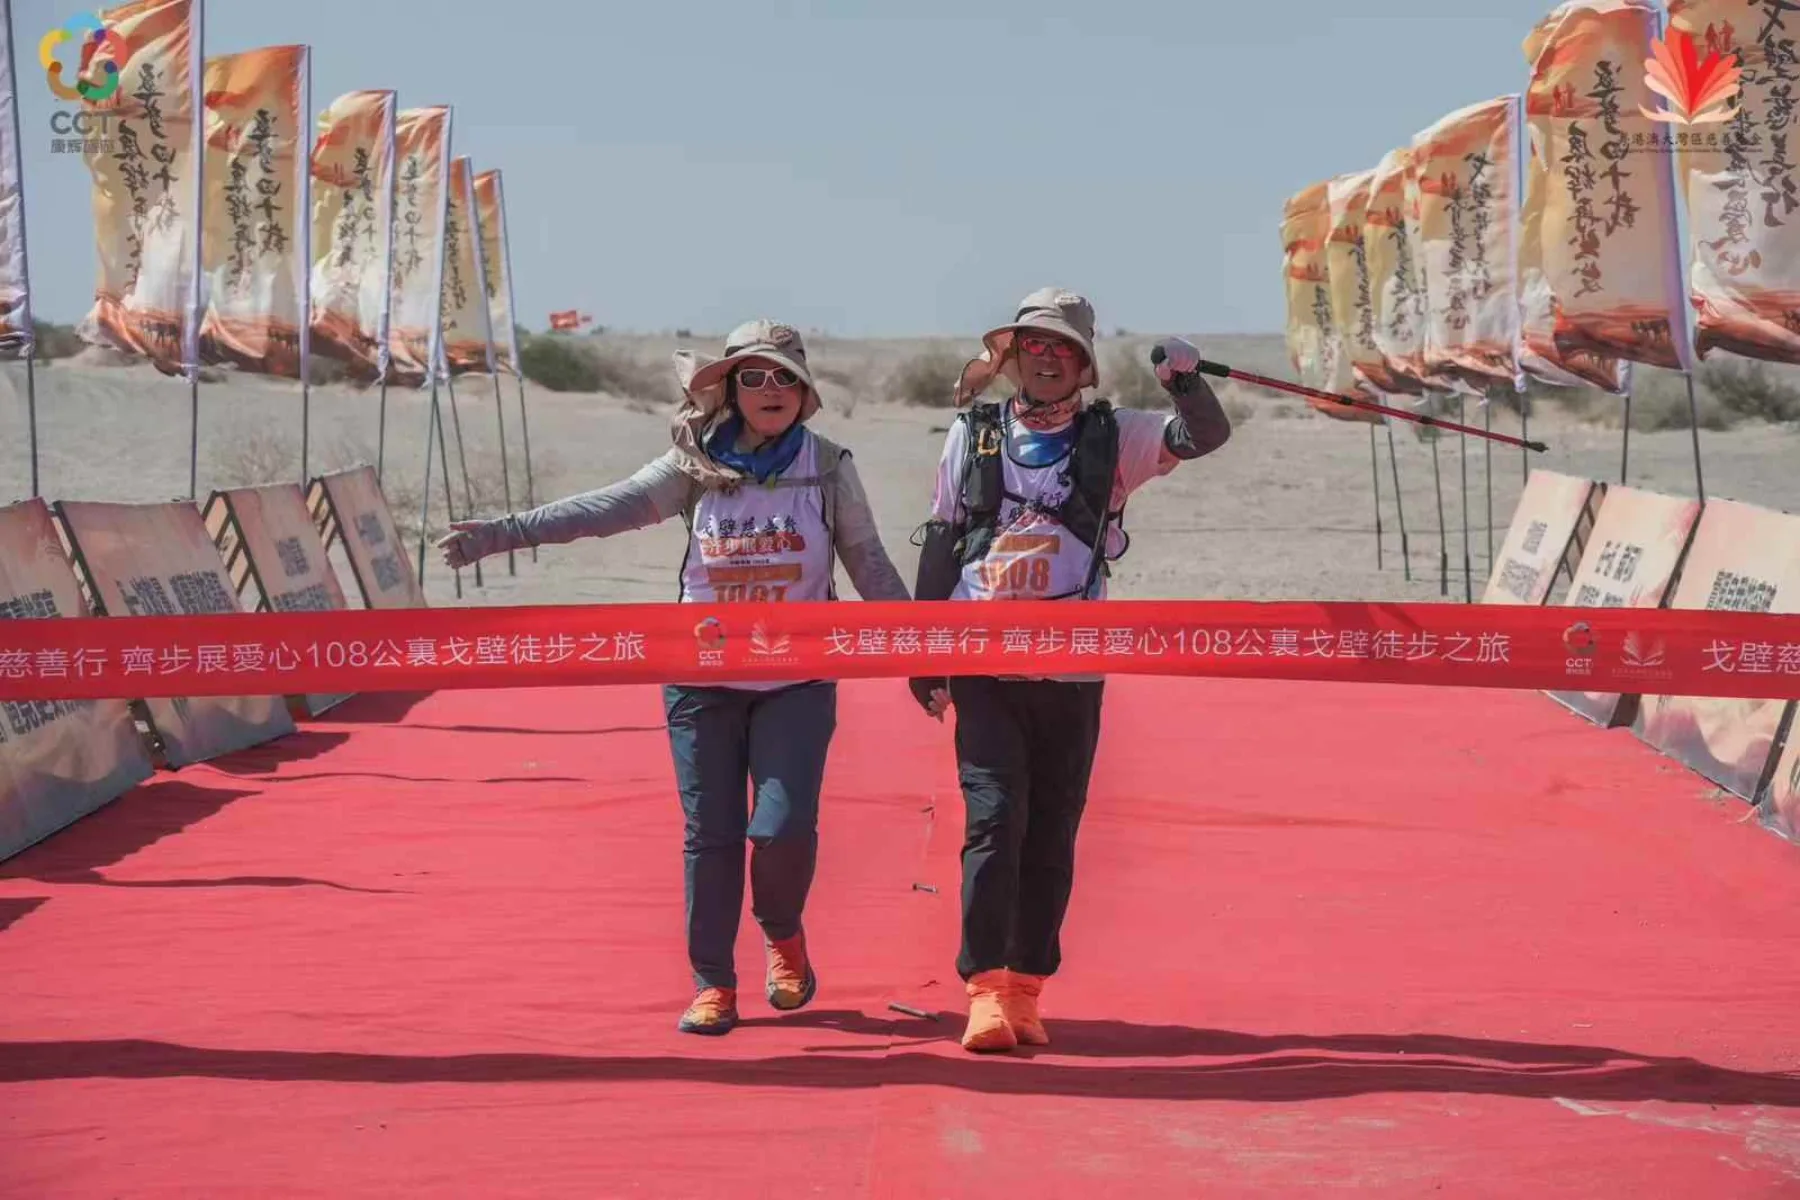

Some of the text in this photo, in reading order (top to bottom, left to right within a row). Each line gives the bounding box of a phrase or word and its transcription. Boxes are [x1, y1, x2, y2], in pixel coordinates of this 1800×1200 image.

[0, 630, 646, 679] 慈善行 齊步展愛心108公裏戈壁徒步之旅
[823, 626, 1511, 663] 戈壁慈善行 齊步展愛心108公裏戈壁徒步之旅
[1565, 658, 1593, 668] CCT
